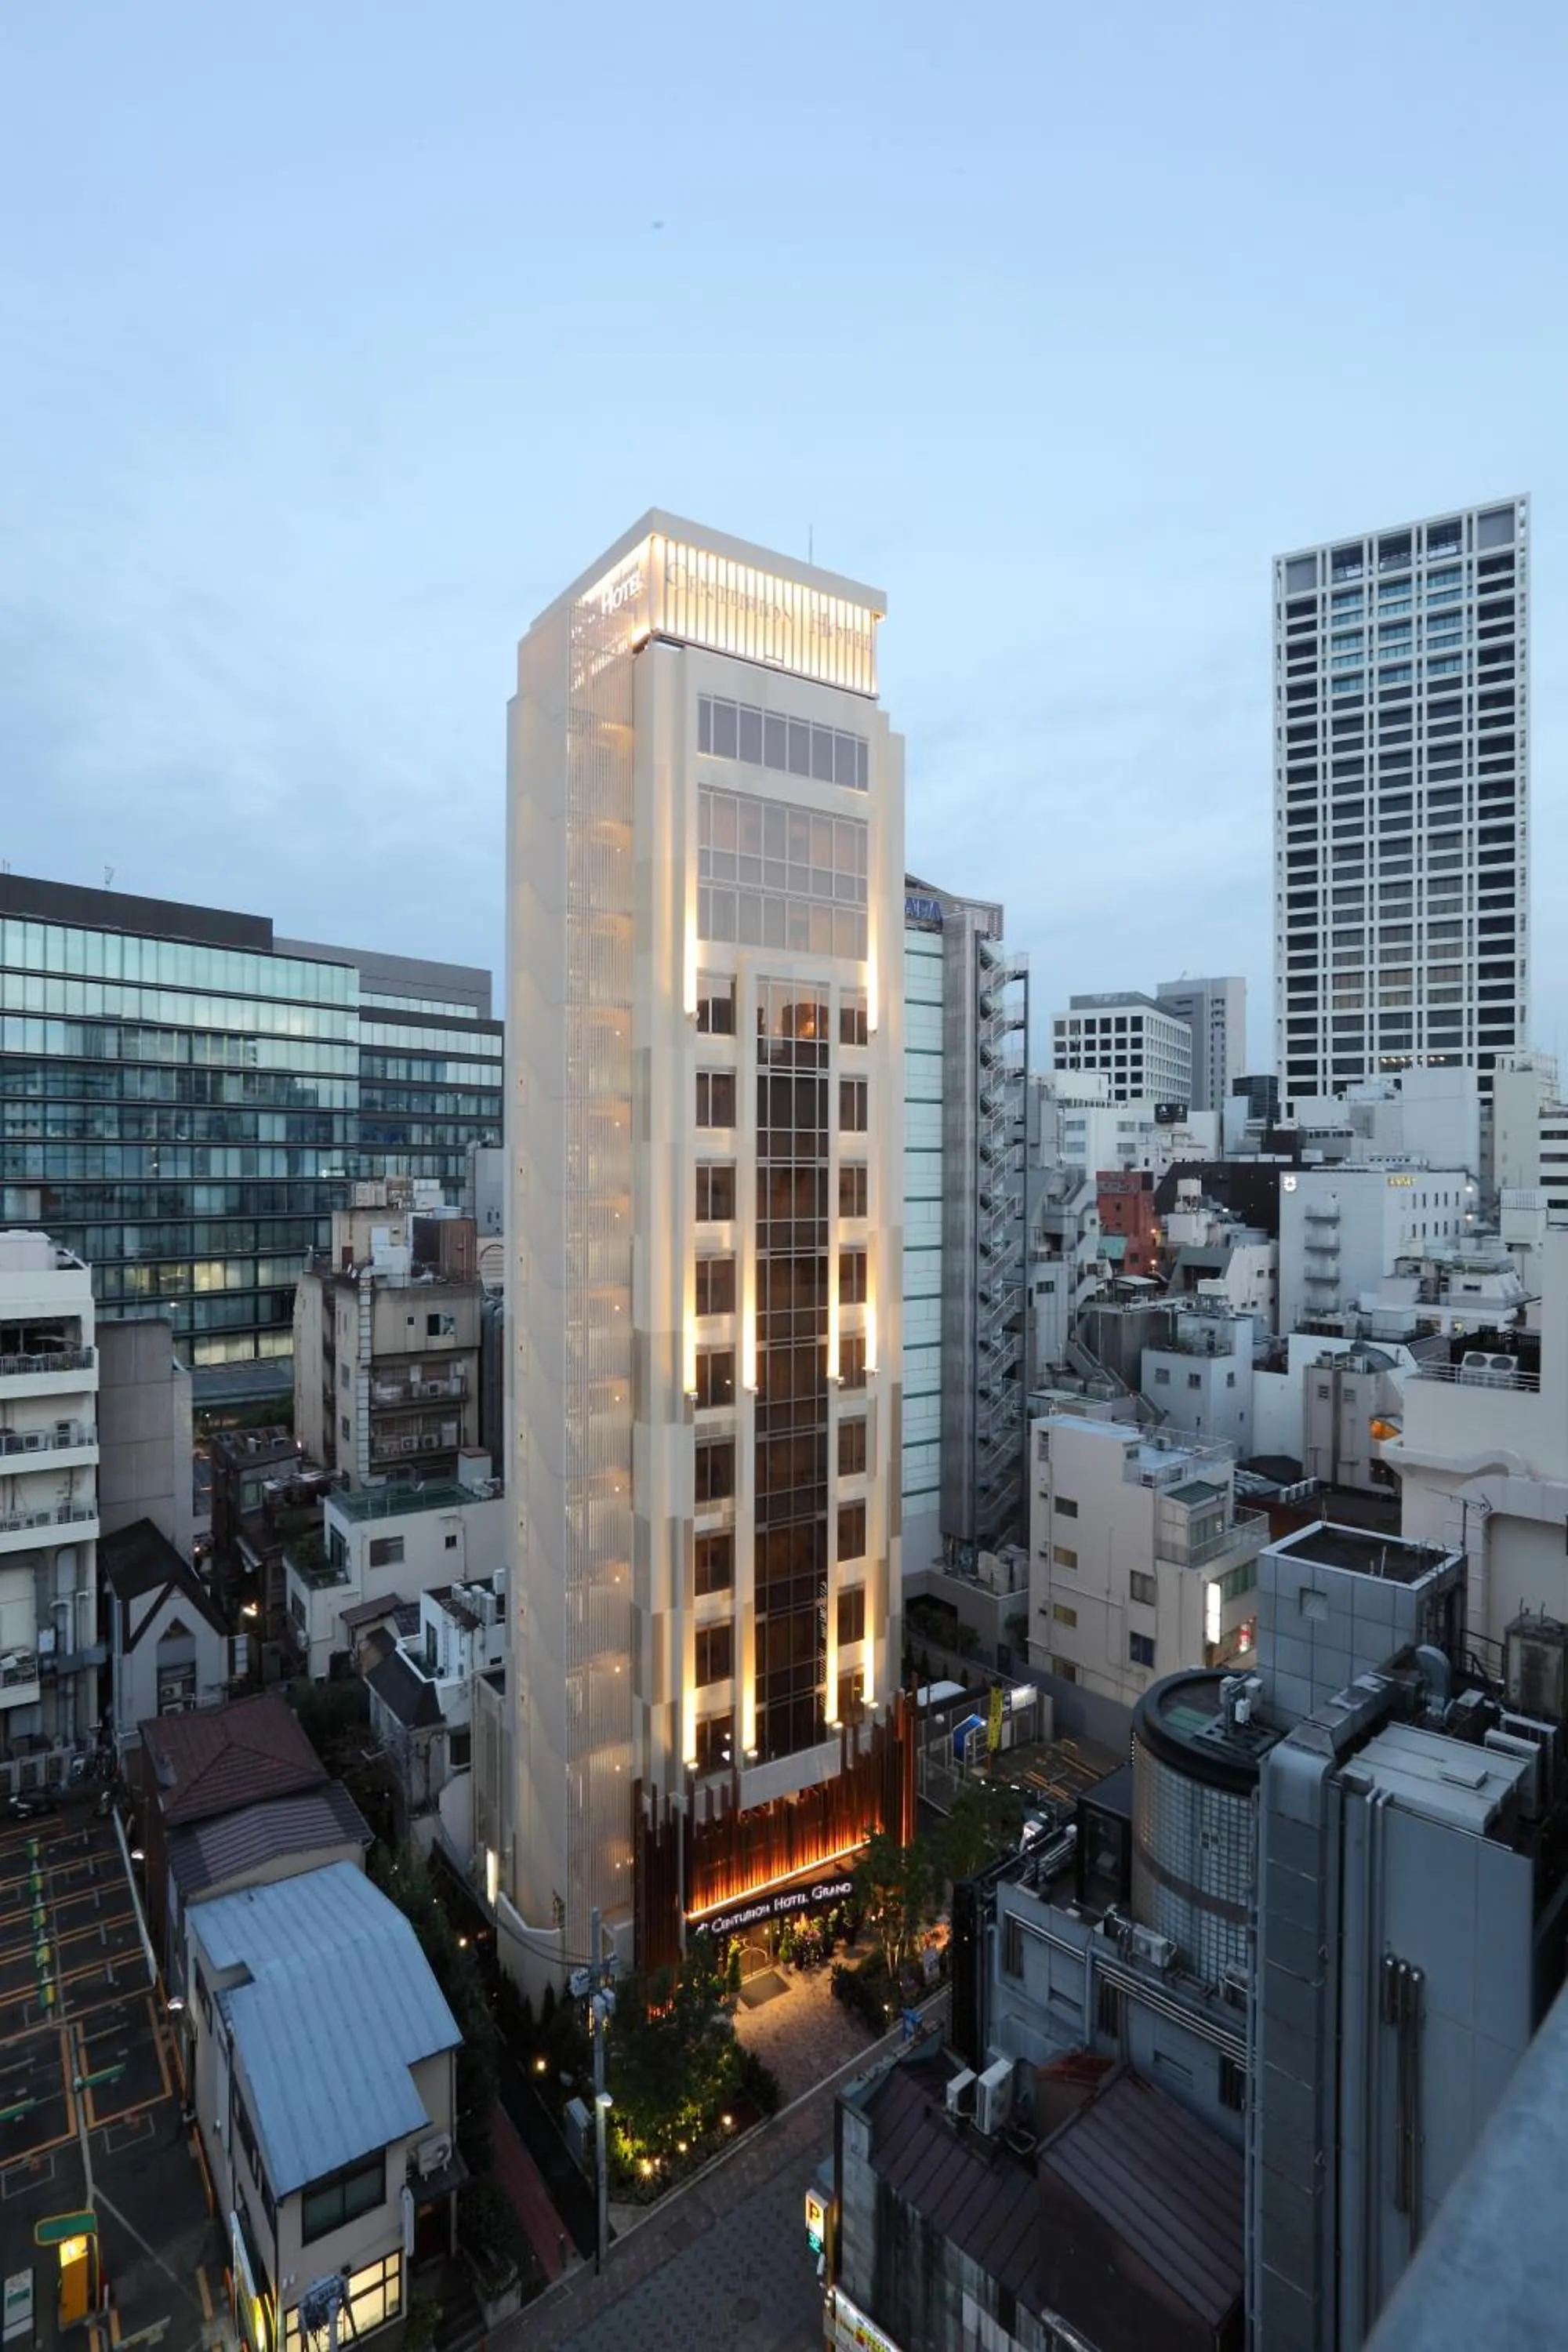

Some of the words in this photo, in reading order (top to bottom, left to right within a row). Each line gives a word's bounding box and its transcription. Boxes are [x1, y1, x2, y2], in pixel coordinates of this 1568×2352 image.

[712, 1904, 770, 1933] CENTURION
[775, 1893, 809, 1911] HOTEL
[811, 1882, 852, 1900] GRAND
[809, 2201, 820, 2219] P
